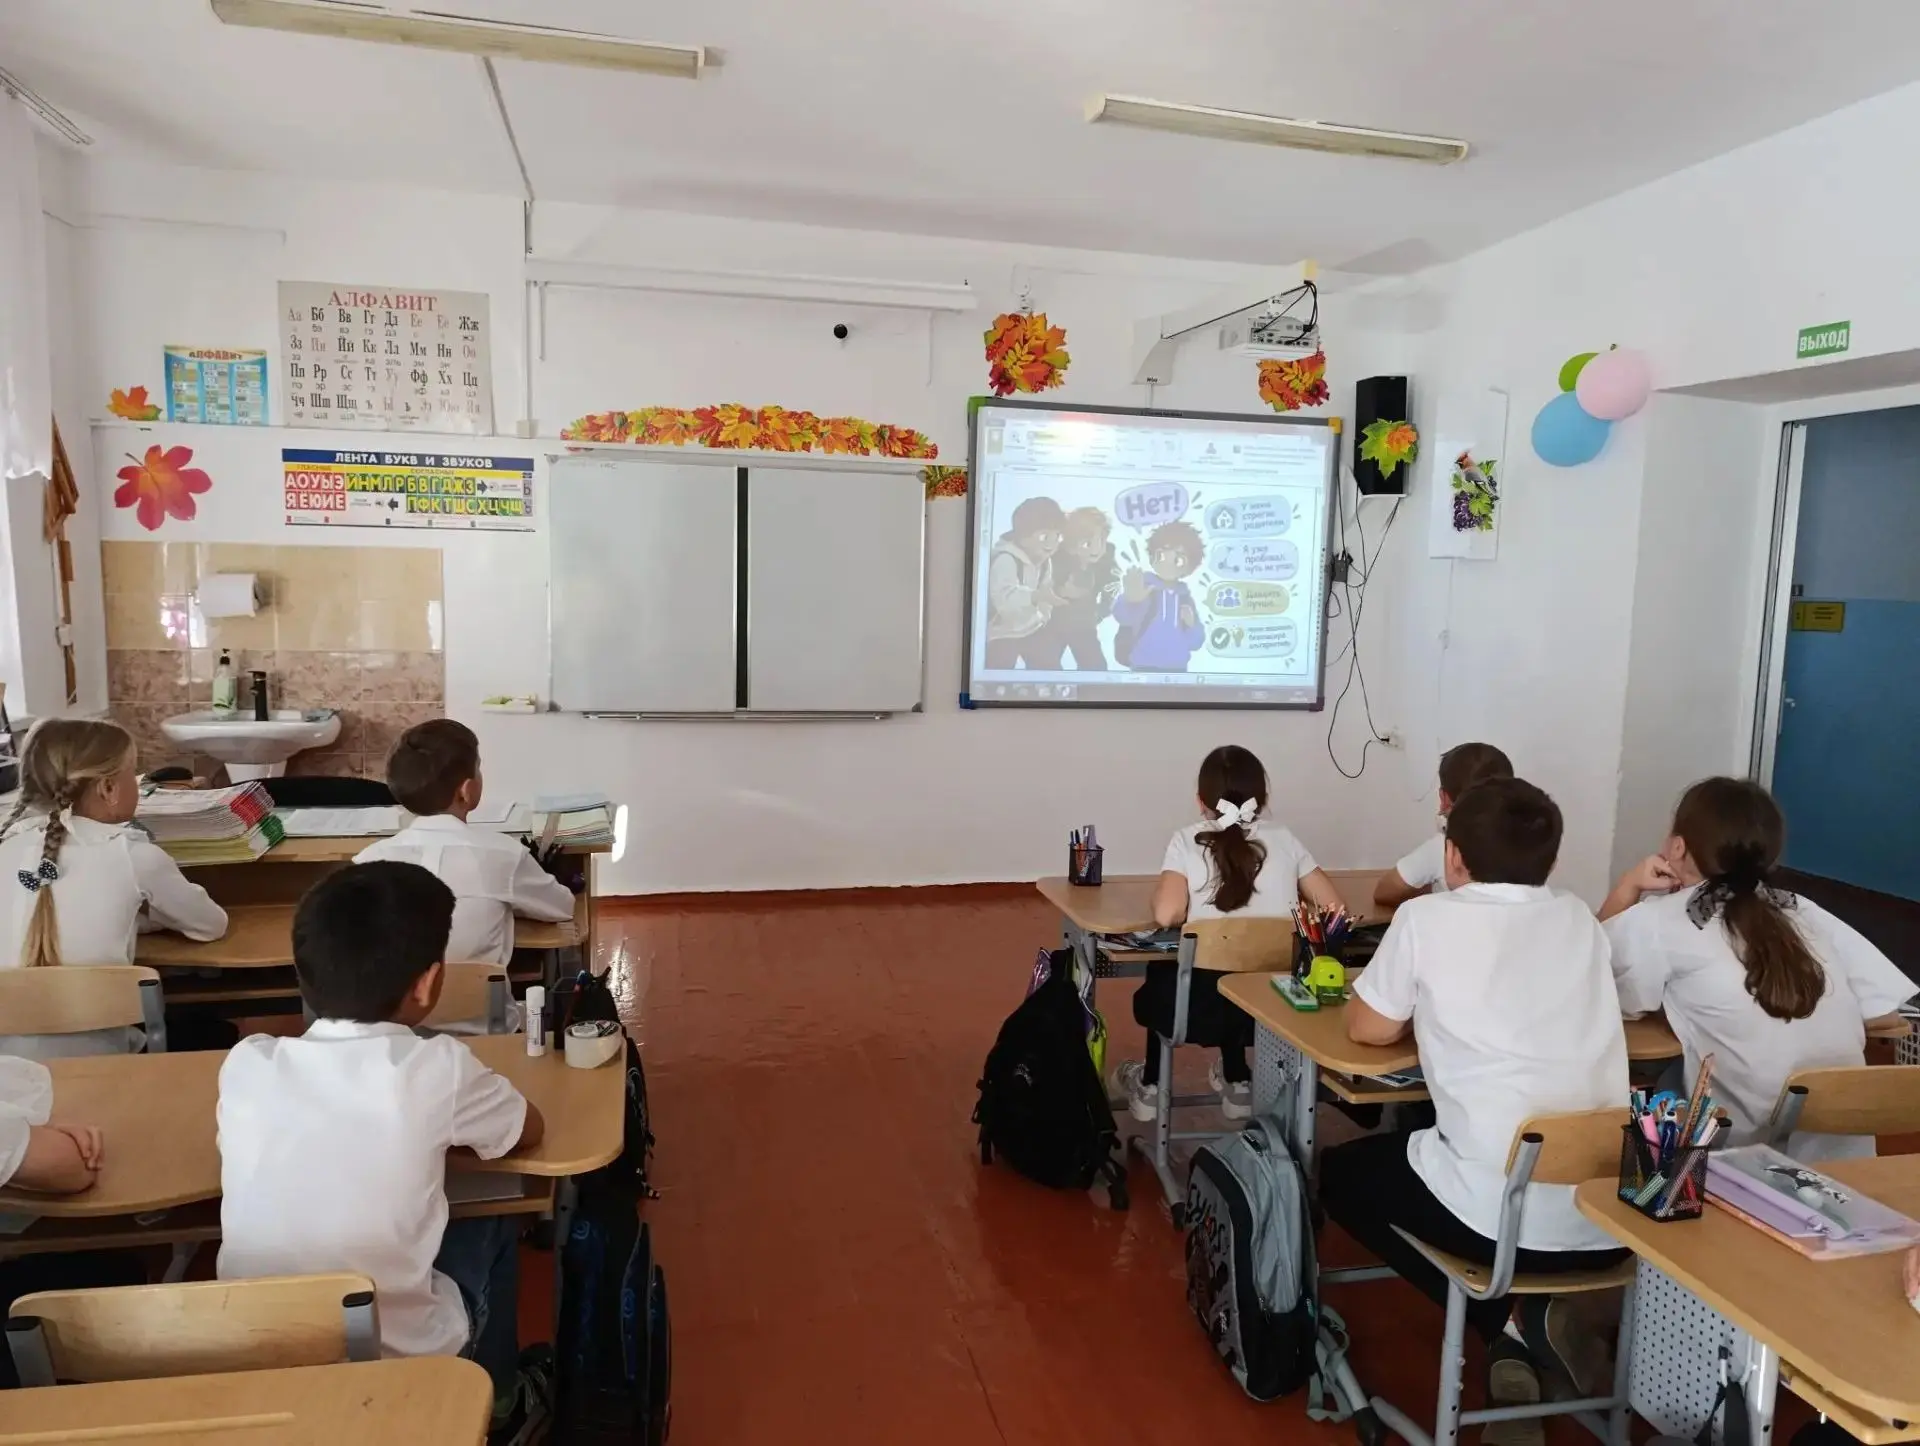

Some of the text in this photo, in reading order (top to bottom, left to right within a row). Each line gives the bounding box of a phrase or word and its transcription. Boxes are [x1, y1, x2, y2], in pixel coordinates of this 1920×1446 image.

[327, 290, 438, 311] АЛФАВИТ
[311, 306, 325, 321] Бб
[338, 308, 352, 323] Вв
[363, 309, 375, 324] Гг
[384, 311, 398, 327] Дд
[458, 315, 479, 331] Жж
[290, 334, 303, 350] Зз
[362, 338, 377, 354] Кк
[384, 339, 400, 355] Лл
[409, 341, 427, 357] Мм
[437, 343, 452, 358] Нн
[1799, 328, 1848, 352] ВЫХОД
[290, 363, 305, 378] Пп
[313, 363, 327, 382] Рр
[340, 364, 353, 380] Сс
[364, 366, 376, 381] Тт
[410, 369, 429, 387] Фф
[438, 370, 453, 385] Хх
[463, 371, 479, 387] Цц
[310, 393, 331, 409] Шш
[336, 394, 358, 411] Щщ
[334, 452, 494, 469] ЛЕНТА БУКВ И ЗВУКОВ
[1124, 488, 1181, 521] Нет!
